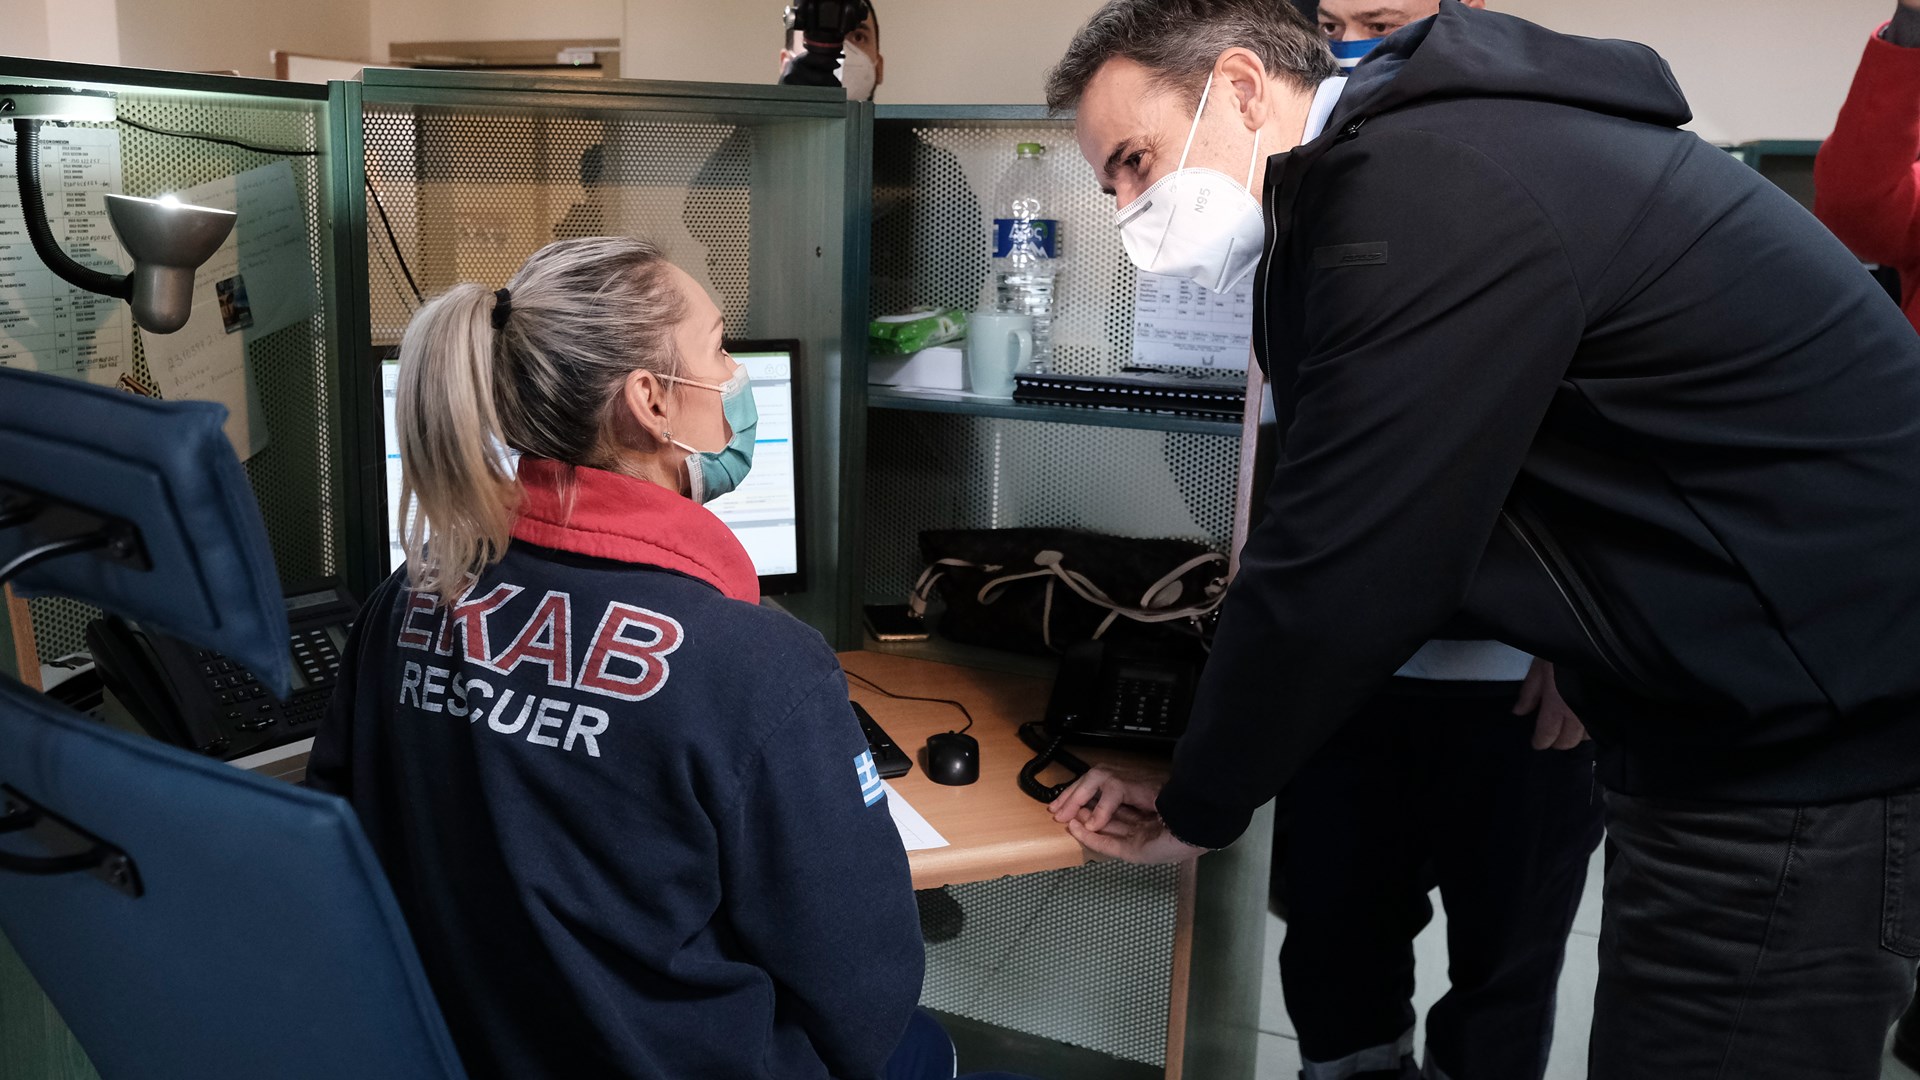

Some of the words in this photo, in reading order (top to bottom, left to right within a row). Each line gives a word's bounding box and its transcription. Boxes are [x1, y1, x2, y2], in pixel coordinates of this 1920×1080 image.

[1194, 187, 1211, 213] N95
[397, 562, 685, 702] EKAB
[399, 660, 610, 758] RESCUER
